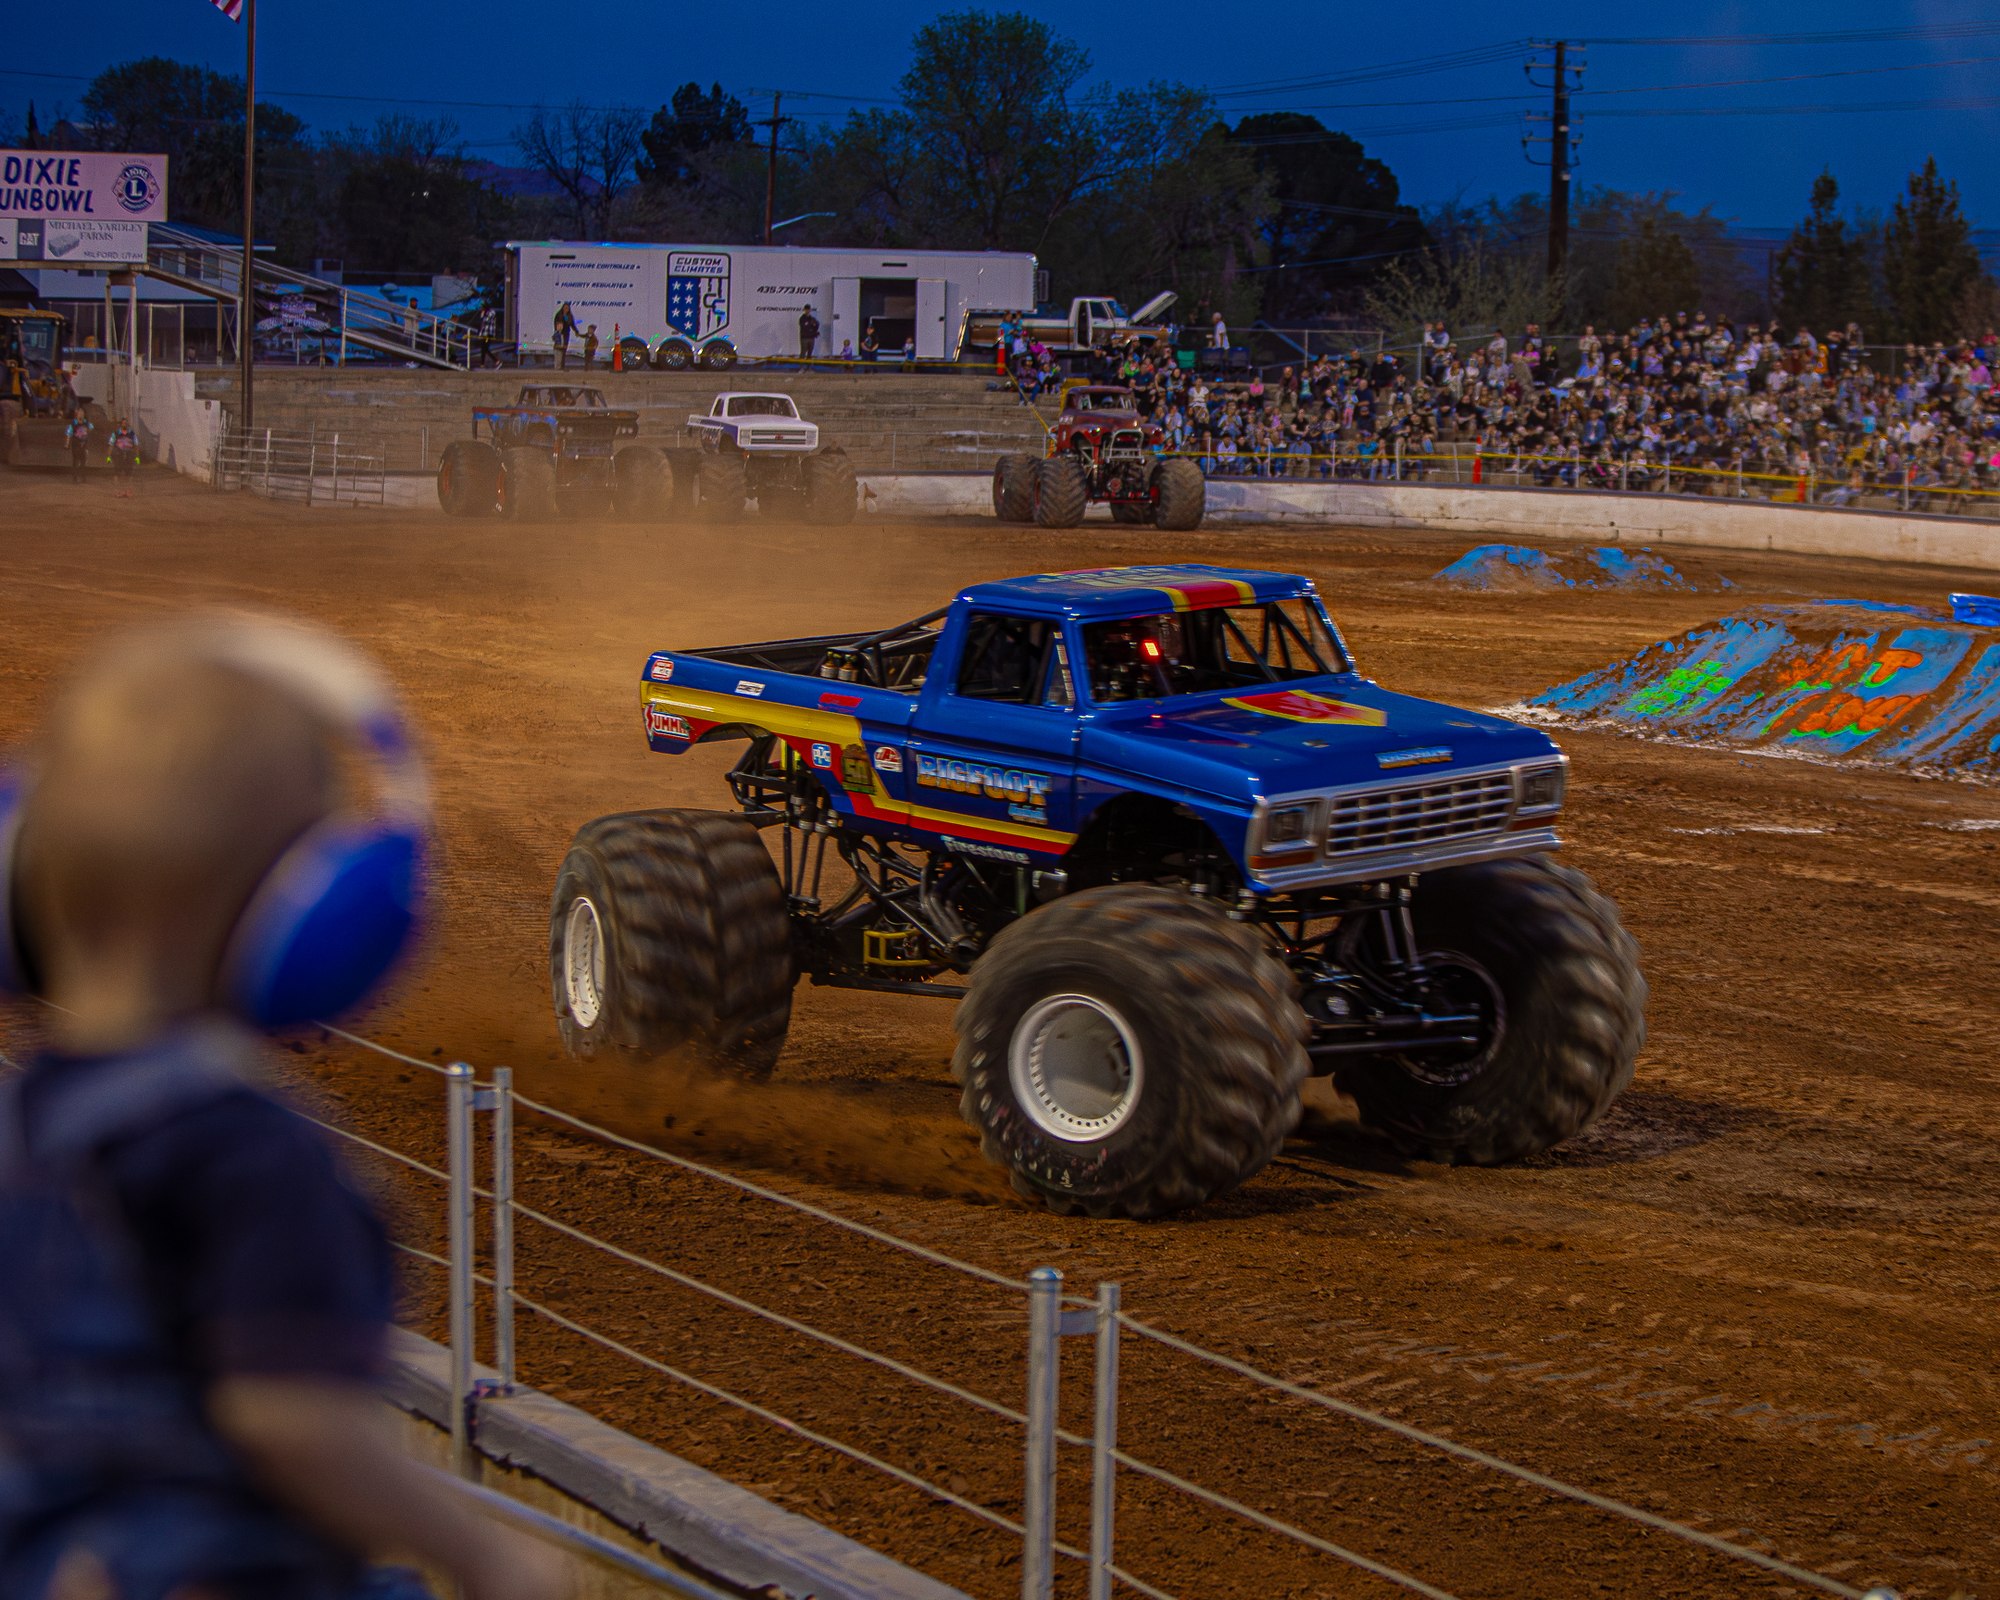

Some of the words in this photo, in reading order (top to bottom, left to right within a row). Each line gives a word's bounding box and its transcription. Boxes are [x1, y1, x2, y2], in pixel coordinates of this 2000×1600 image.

[4, 157, 81, 186] DIXIE
[49, 221, 96, 230] MICHAEL
[99, 222, 143, 232] YARDLEY
[19, 232, 40, 246] CAT
[80, 232, 114, 241] FARMS
[676, 257, 722, 266] CUSTOM
[673, 265, 723, 274] CLIMATES
[757, 285, 818, 295] 435.773.1076
[915, 753, 1052, 806] BIGFOOT
[940, 835, 1031, 865] Firestone
